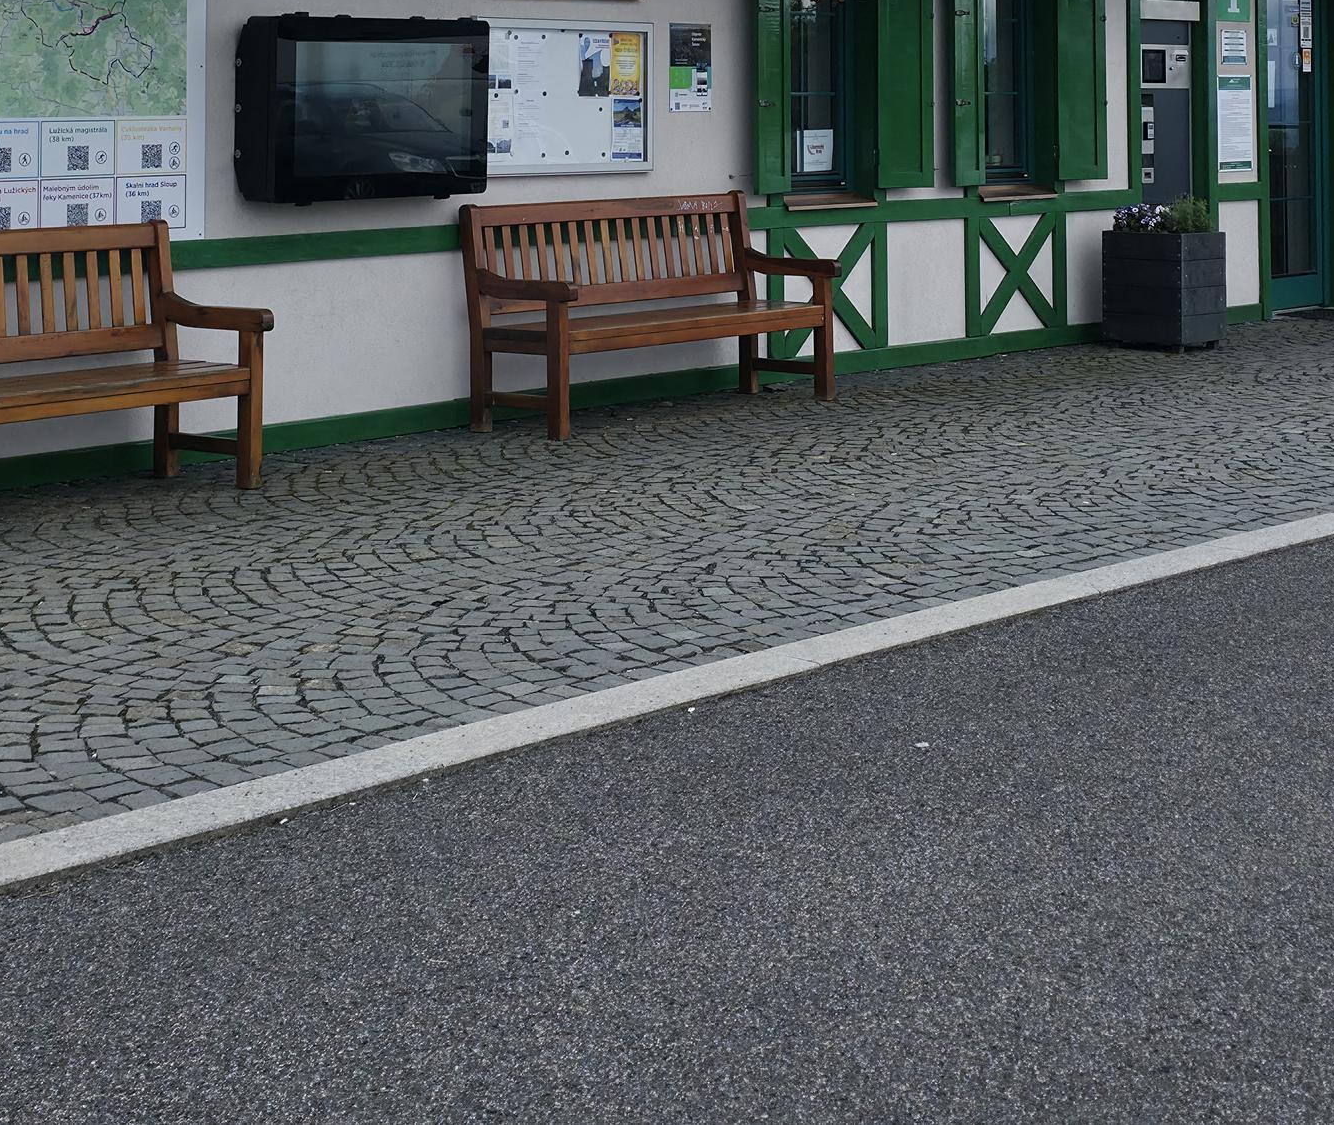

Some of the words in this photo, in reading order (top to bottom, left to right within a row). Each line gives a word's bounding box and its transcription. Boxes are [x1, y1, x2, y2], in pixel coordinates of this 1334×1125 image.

[14, 127, 29, 135] hrad
[49, 126, 73, 134] Lužická
[74, 127, 108, 135] magistrála
[49, 136, 60, 144] (38
[3, 186, 37, 195] Lužických
[43, 185, 76, 194] Malebným
[57, 193, 89, 201] Kamenice
